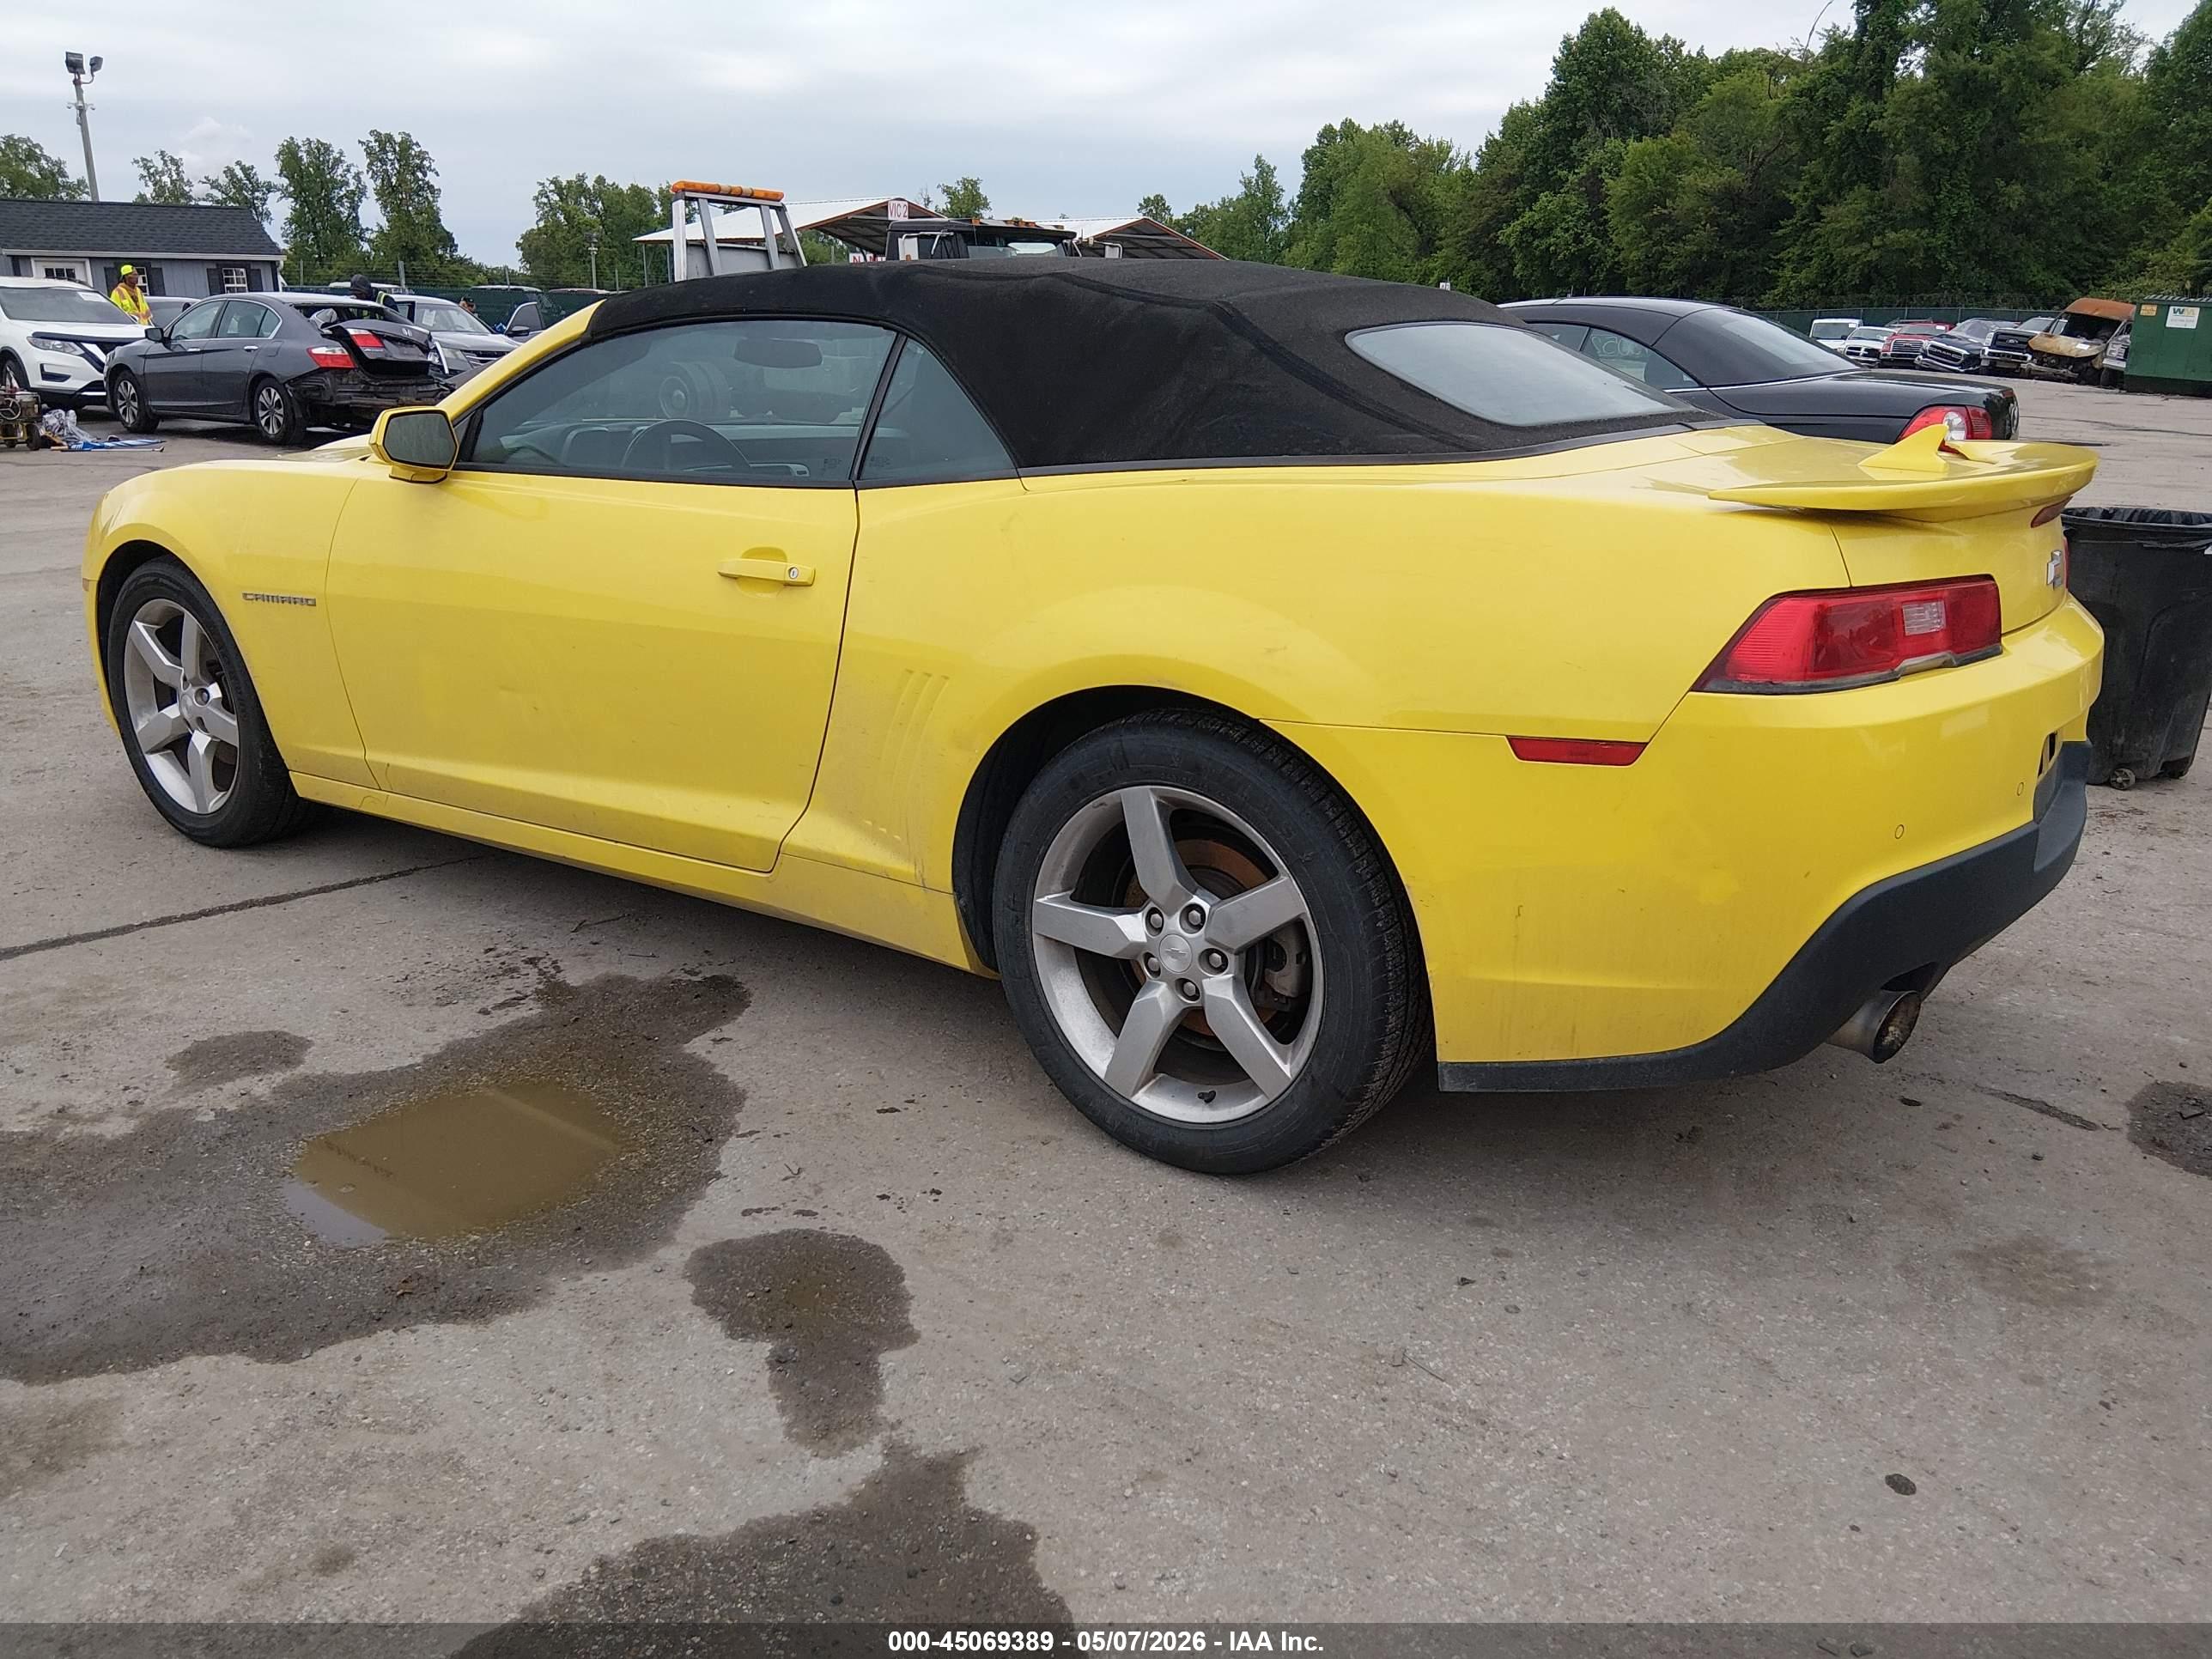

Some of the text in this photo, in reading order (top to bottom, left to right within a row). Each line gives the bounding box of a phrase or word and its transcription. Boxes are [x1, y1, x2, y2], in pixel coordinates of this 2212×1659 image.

[889, 203, 908, 218] VIC 2
[241, 592, 317, 606] CAMARO
